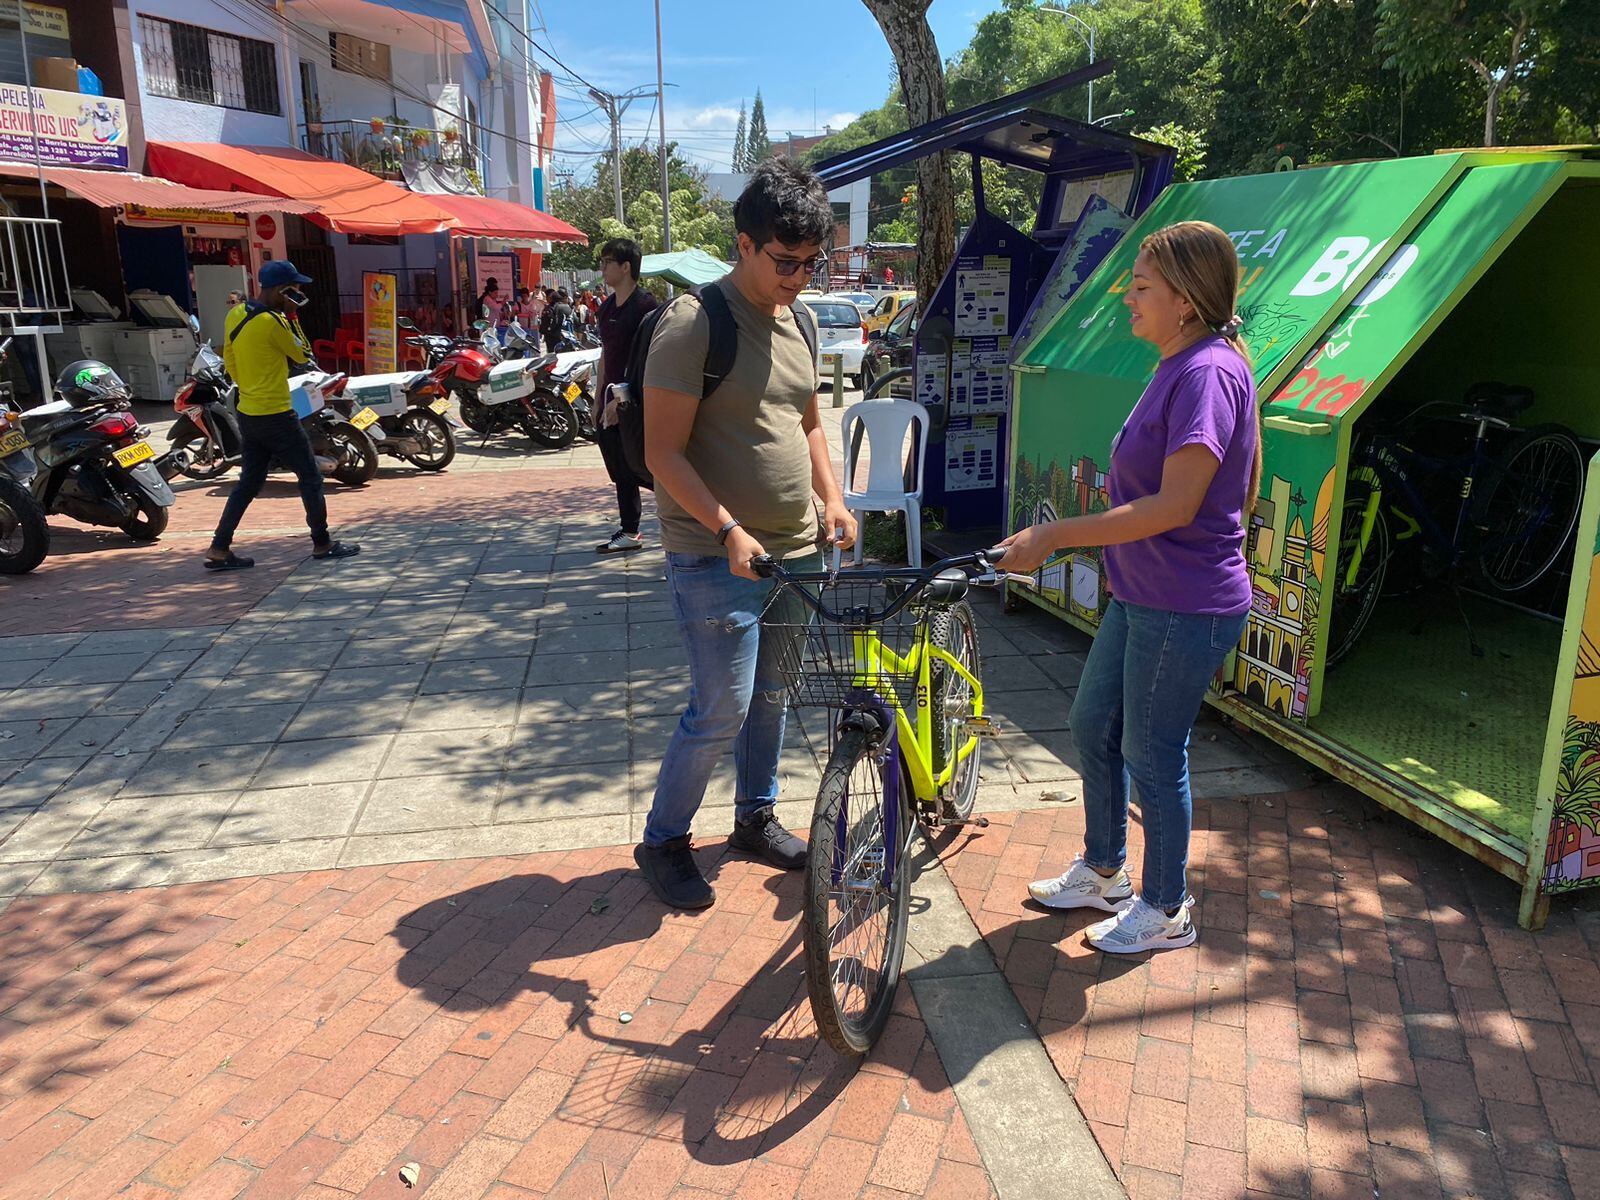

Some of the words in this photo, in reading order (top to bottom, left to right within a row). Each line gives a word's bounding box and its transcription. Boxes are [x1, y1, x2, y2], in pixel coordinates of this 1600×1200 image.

[59, 116, 79, 138] UIS
[12, 134, 32, 143] Local
[45, 139, 67, 147] Barrio
[20, 143, 34, 151] 300
[51, 147, 67, 155] 1281
[1228, 229, 1265, 258] TE
[1252, 228, 1288, 258] A
[917, 685, 928, 708] 013
